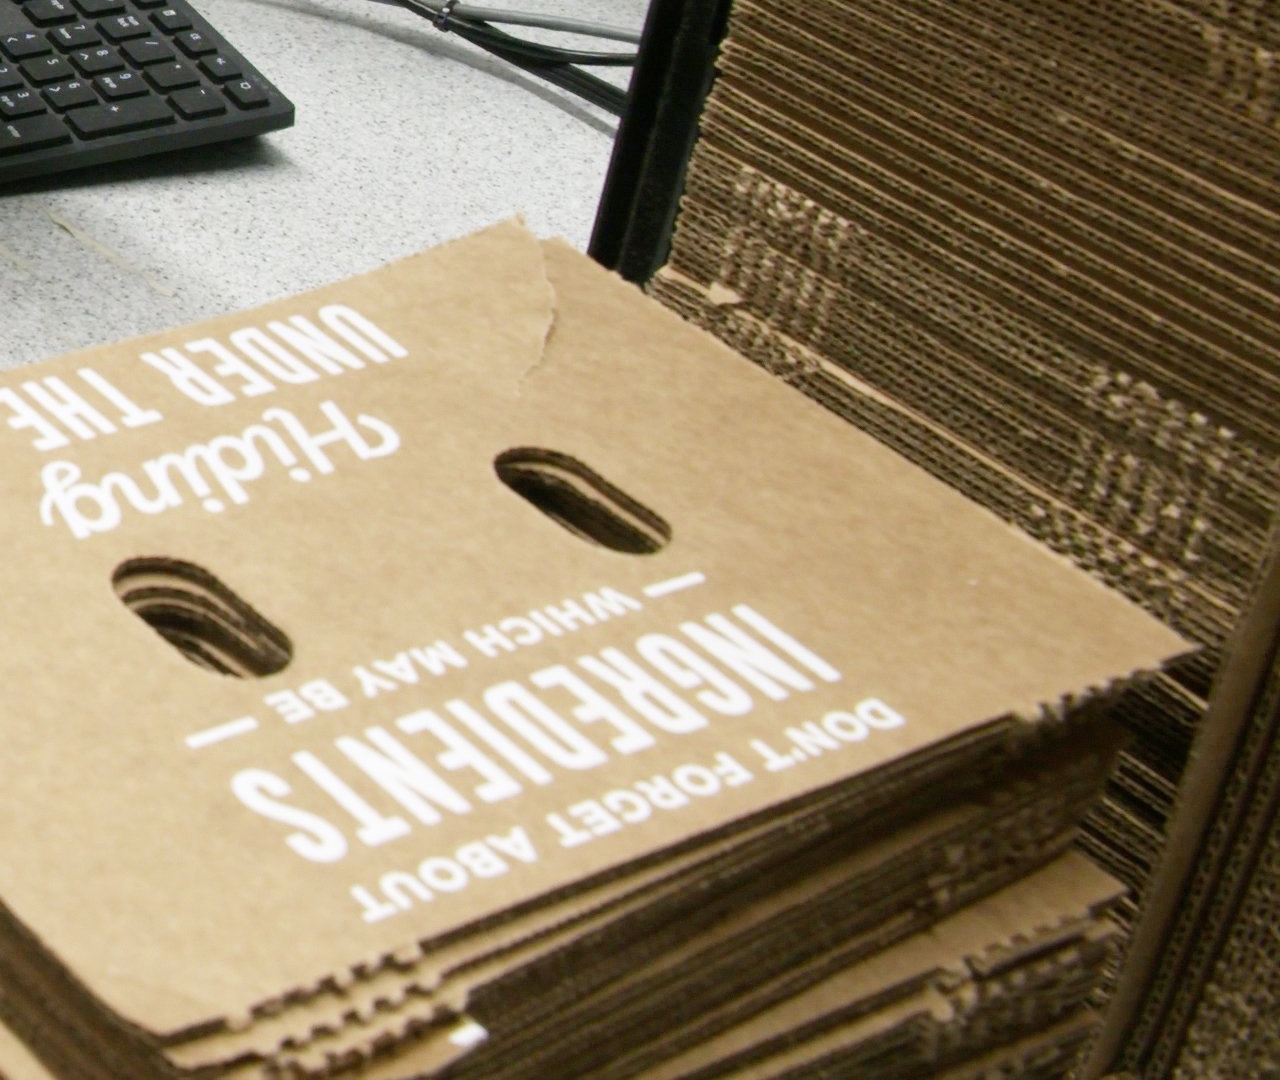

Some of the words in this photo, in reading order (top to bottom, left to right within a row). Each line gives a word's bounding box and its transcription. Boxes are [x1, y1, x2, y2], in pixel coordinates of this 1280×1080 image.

[140, 302, 409, 408] UNDER
[38, 400, 402, 541] Hiding
[349, 639, 469, 700] MAY
[463, 585, 645, 658] WHICH
[229, 602, 842, 866] INGREDIENTS
[262, 678, 352, 724] BE
[748, 697, 907, 773] DON'T
[545, 751, 755, 848] FORGET
[349, 824, 539, 923] ABOUT
